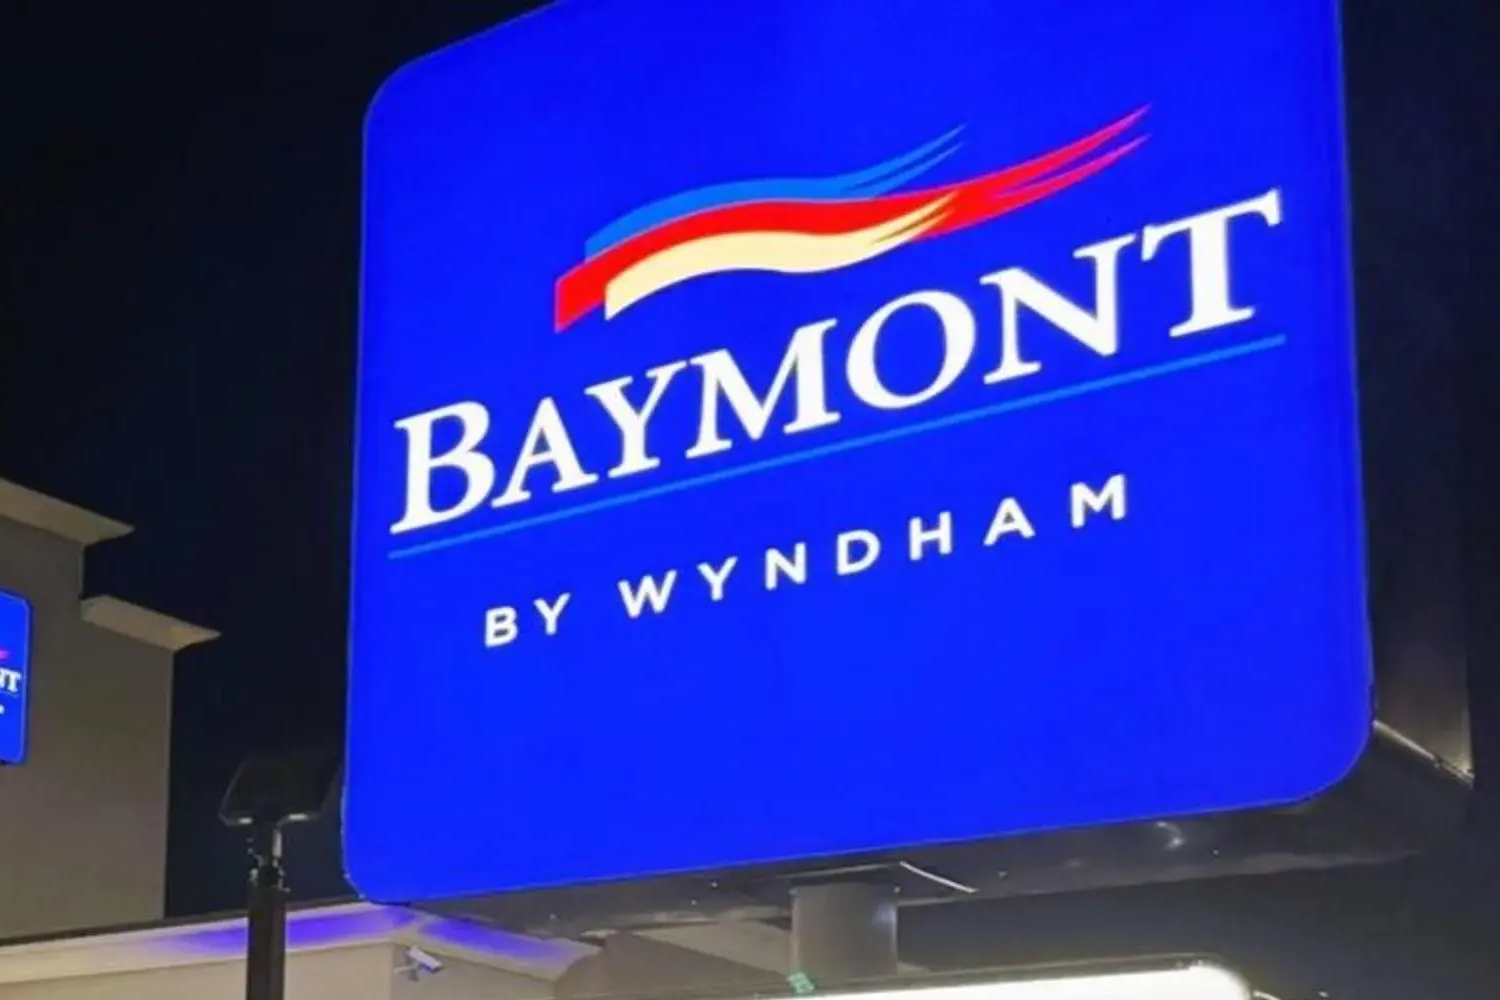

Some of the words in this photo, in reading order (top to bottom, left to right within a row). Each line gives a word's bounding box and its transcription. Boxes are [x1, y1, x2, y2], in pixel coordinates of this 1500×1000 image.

[389, 188, 1283, 535] BAYMONT
[484, 592, 571, 648] BY
[618, 473, 1129, 619] WYNDHAM
